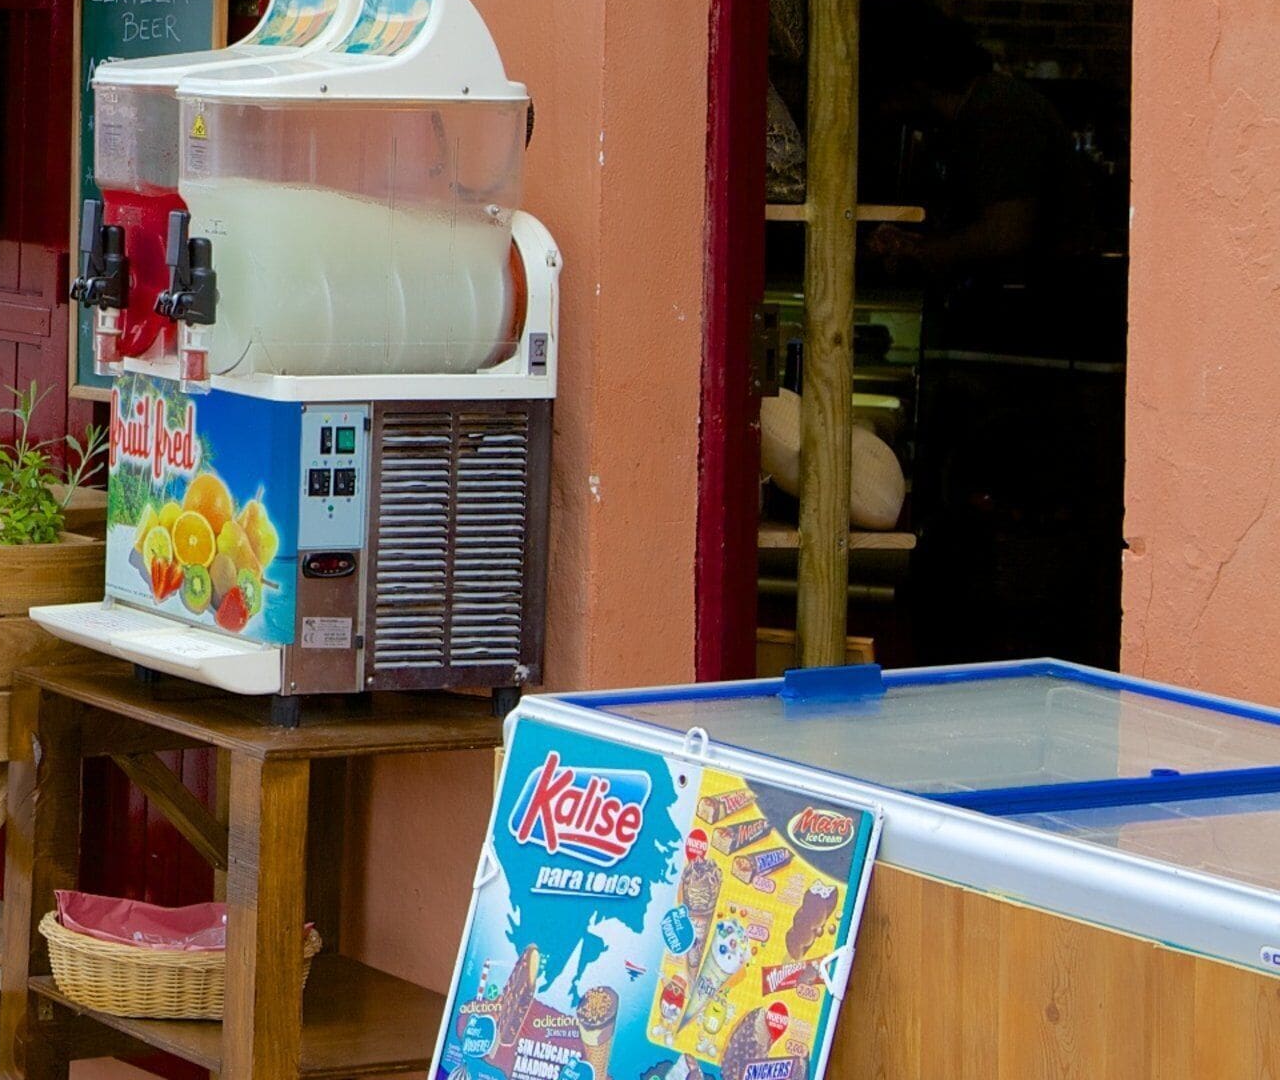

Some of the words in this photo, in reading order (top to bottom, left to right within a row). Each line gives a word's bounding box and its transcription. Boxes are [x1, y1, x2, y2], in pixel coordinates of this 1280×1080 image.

[121, 11, 182, 43] BEER
[109, 388, 151, 468] fruit
[153, 398, 195, 480] fred
[518, 752, 642, 852] Kalise
[795, 806, 854, 837] Mars
[536, 866, 583, 890] para
[585, 871, 642, 897] todos
[459, 1001, 503, 1014] adiction
[744, 1059, 791, 1080] SNICKERS
